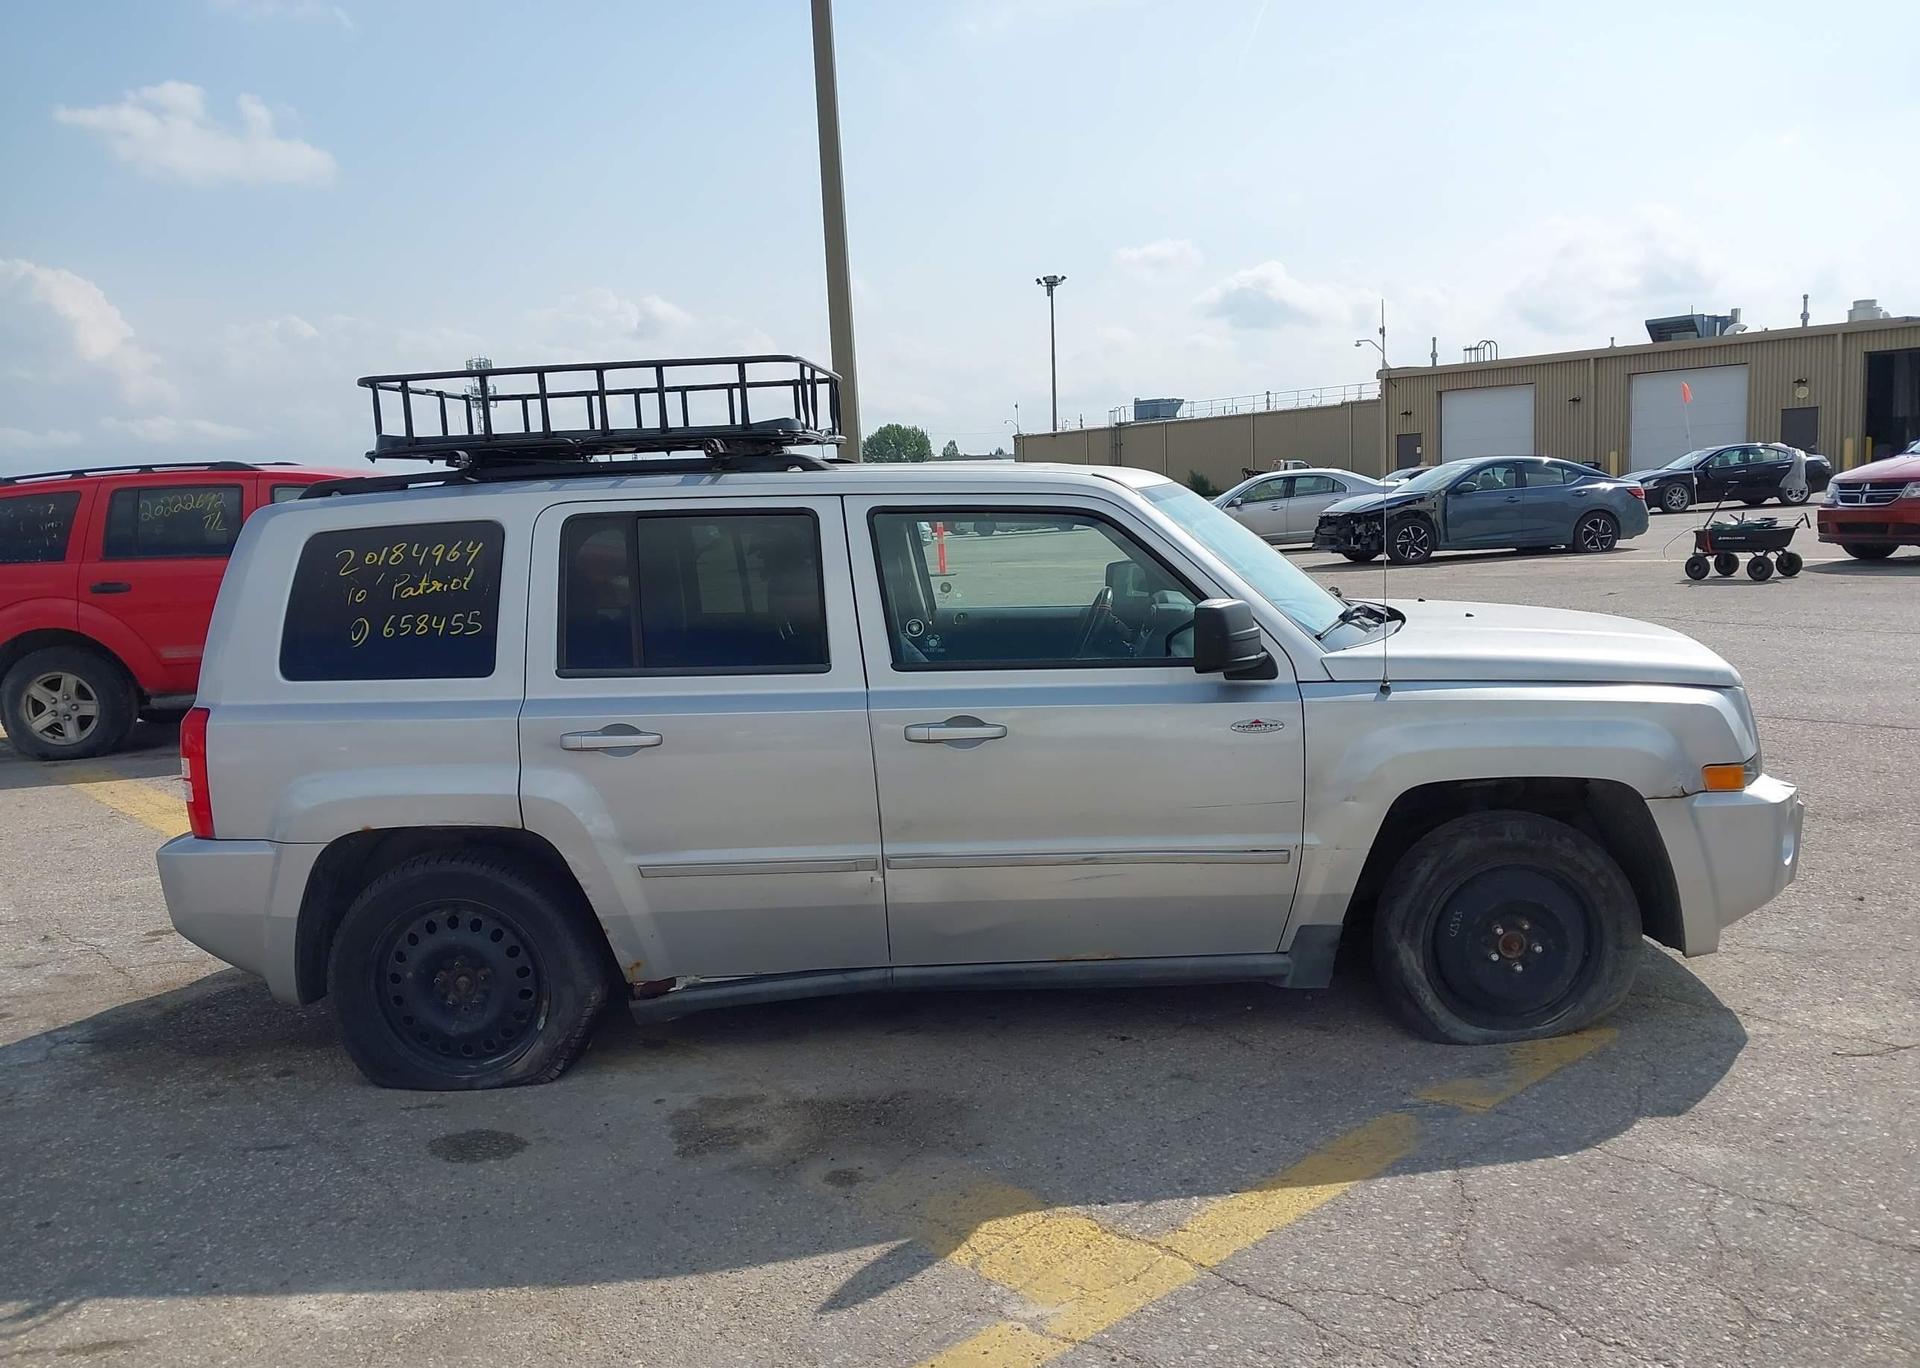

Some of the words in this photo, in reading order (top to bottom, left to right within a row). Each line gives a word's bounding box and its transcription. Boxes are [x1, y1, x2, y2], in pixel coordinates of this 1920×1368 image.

[335, 540, 483, 576] 20184964
[392, 568, 475, 600] Patriot
[382, 610, 483, 638] 658455
